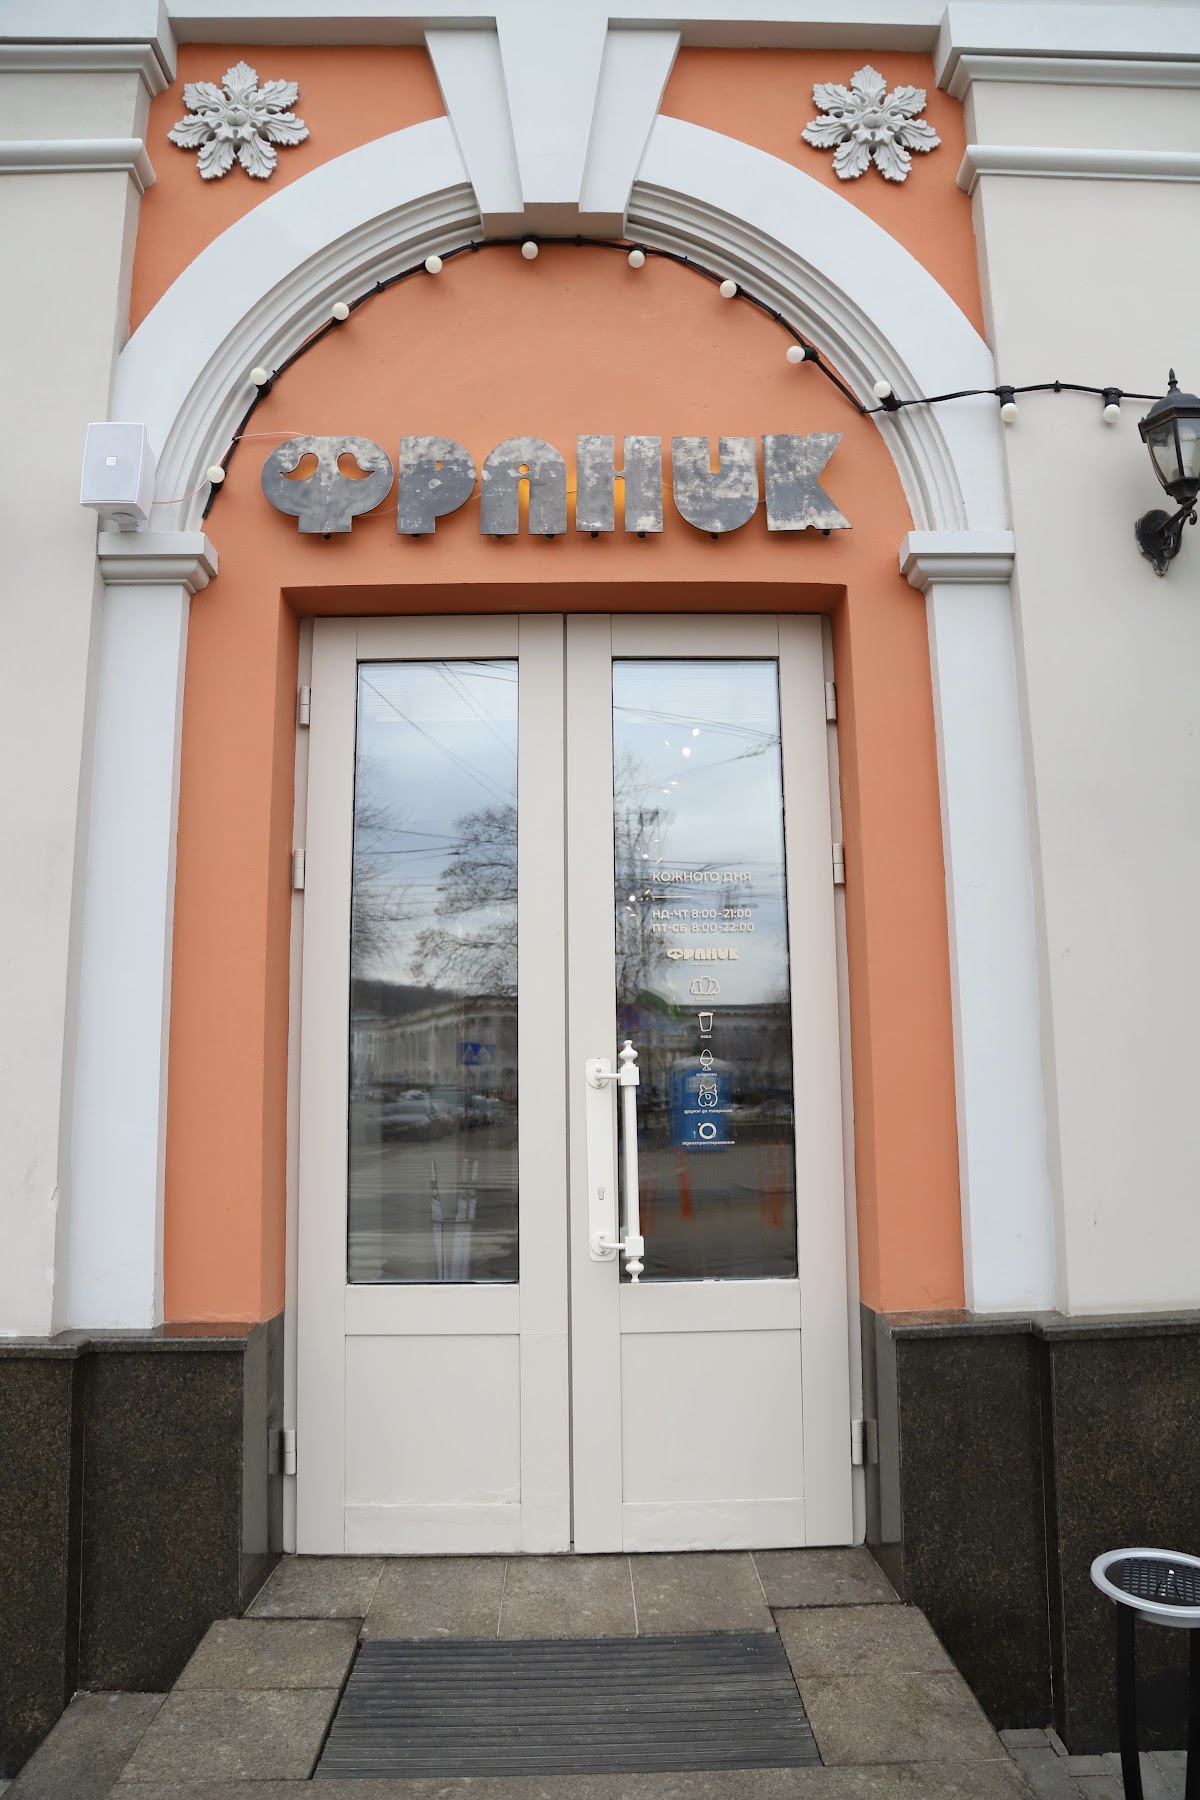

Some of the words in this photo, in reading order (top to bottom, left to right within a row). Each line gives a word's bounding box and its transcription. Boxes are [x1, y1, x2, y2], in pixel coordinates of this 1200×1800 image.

[652, 871, 720, 882] КОЖНОГО
[723, 871, 752, 883] ДНЯ
[652, 909, 689, 919] НД-ЧТ
[691, 909, 717, 918] 8:00
[652, 923, 688, 932] ПТ-СБ
[691, 922, 717, 932] 8:00
